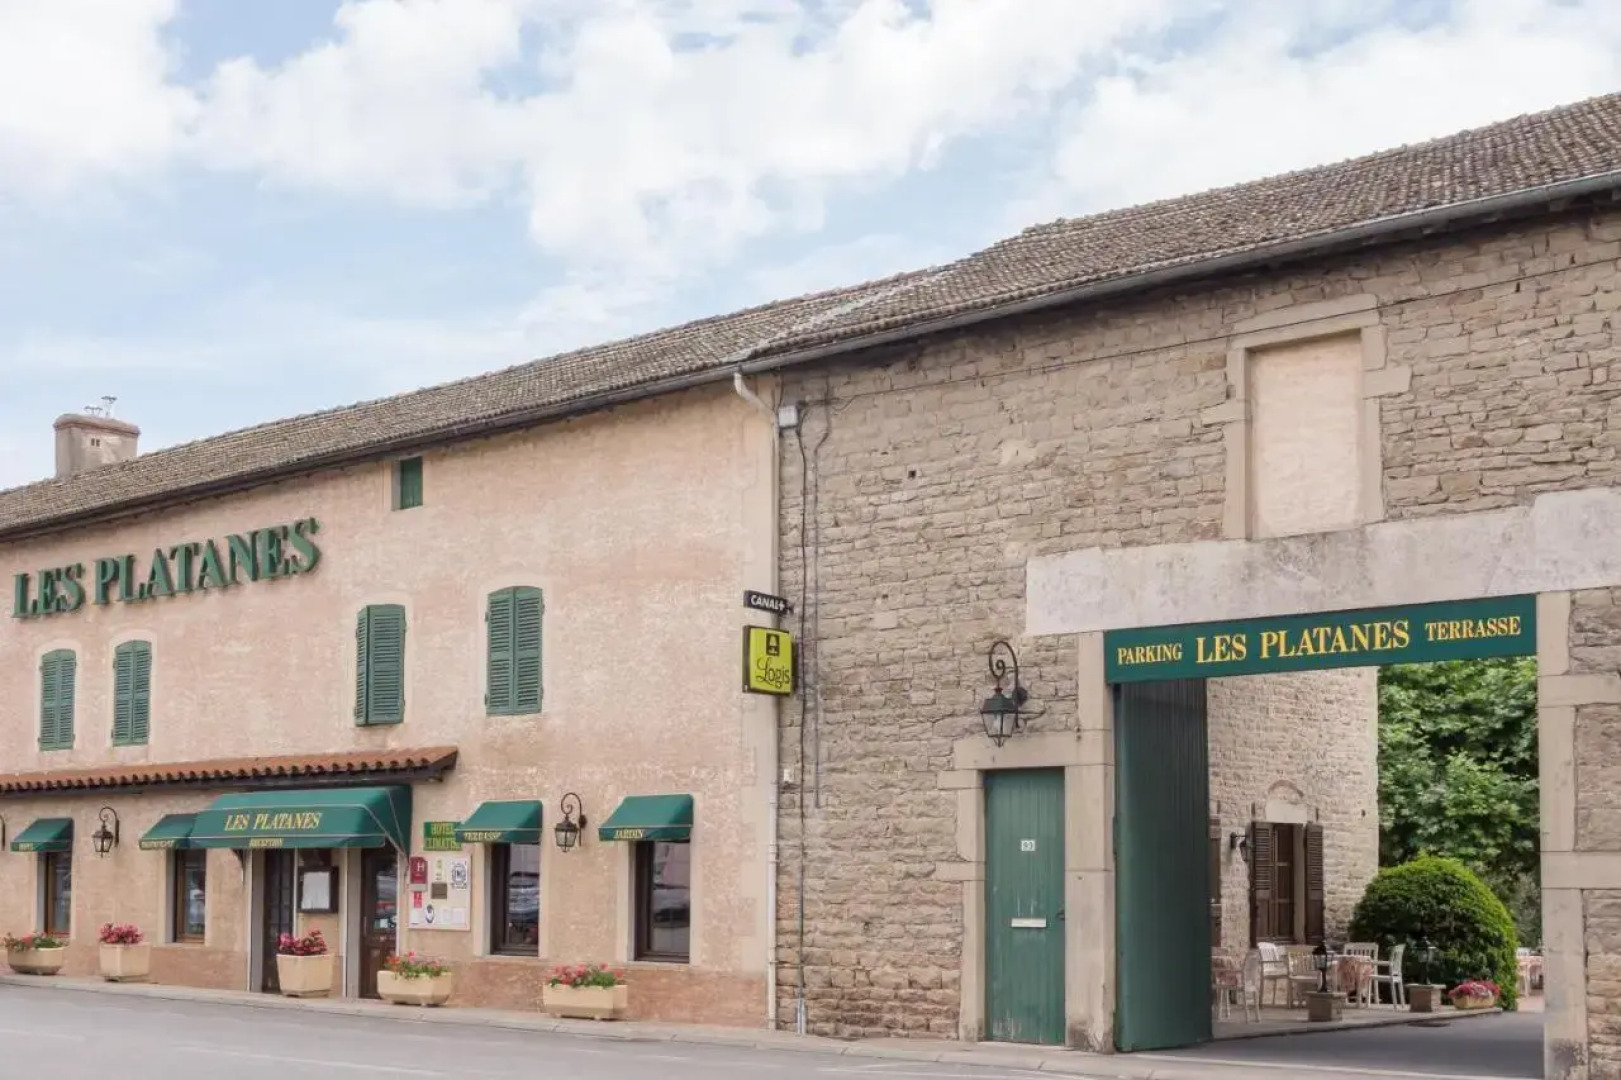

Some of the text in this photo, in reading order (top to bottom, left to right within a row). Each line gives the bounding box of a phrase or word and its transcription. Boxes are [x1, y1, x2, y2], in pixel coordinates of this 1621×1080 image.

[12, 517, 321, 618] LES PLATANES
[750, 594, 786, 611] CANAL+
[1117, 615, 1521, 666] PARKING LES PLATANES TERRASSE
[755, 656, 790, 689] Logis
[224, 812, 323, 831] LES PLATANES
[417, 861, 425, 872] H
